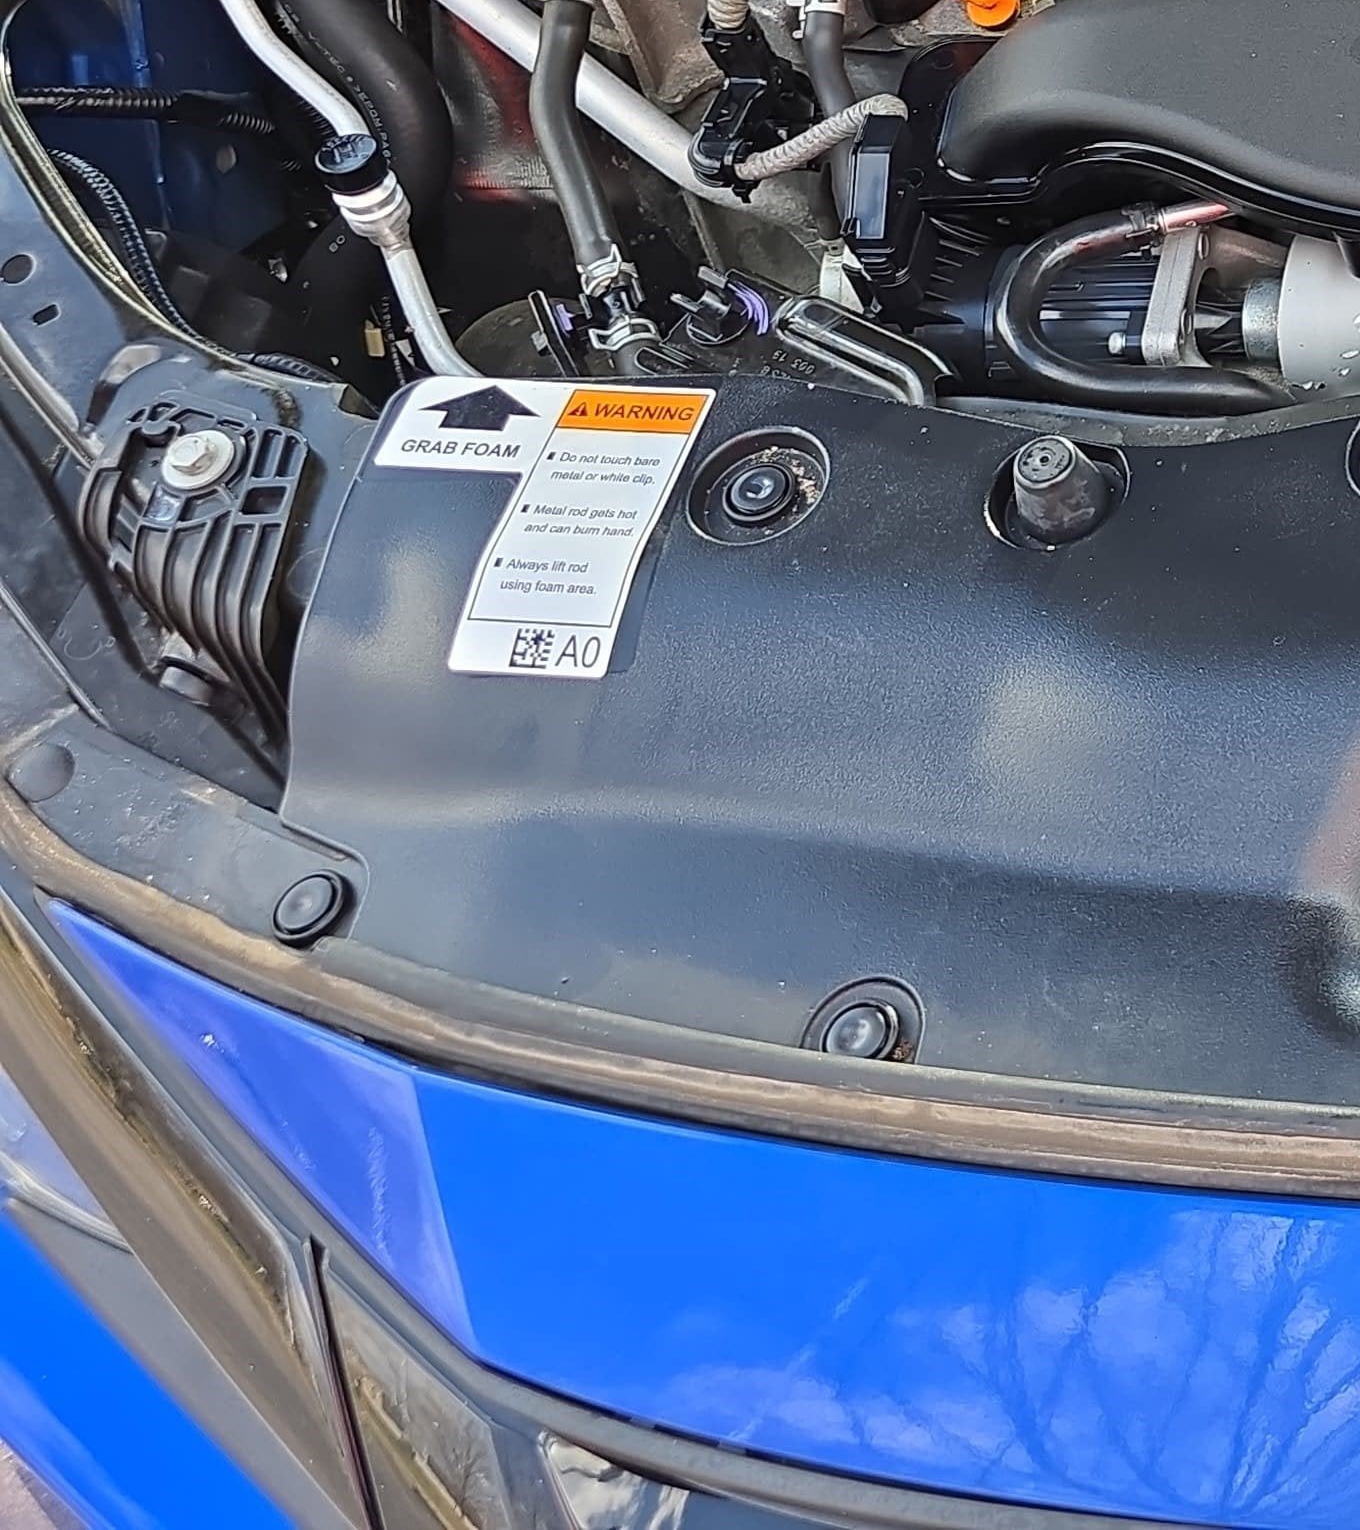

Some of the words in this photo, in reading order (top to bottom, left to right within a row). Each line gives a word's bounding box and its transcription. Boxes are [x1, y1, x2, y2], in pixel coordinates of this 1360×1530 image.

[594, 403, 696, 421] WARNING
[401, 439, 458, 455] GRAB
[463, 442, 521, 458] FOAM
[560, 452, 578, 463] Do
[579, 454, 599, 464] not
[601, 454, 632, 466] touch
[634, 456, 660, 467] bare
[551, 470, 584, 482] metal
[585, 473, 599, 482] or
[600, 471, 631, 483] white
[632, 473, 656, 486] clip.
[533, 504, 568, 516] Metal
[568, 506, 588, 517] rod
[588, 508, 616, 520] gets
[617, 509, 638, 519] hot
[525, 523, 549, 534] and
[550, 526, 572, 535] can
[573, 525, 600, 536] burn
[602, 526, 634, 537] hand.
[507, 559, 549, 574] Always
[552, 560, 567, 572] lift
[568, 562, 589, 573] rod
[500, 580, 532, 594] using
[535, 581, 564, 593] foam
[567, 584, 597, 595] area.
[556, 634, 601, 668] A0
